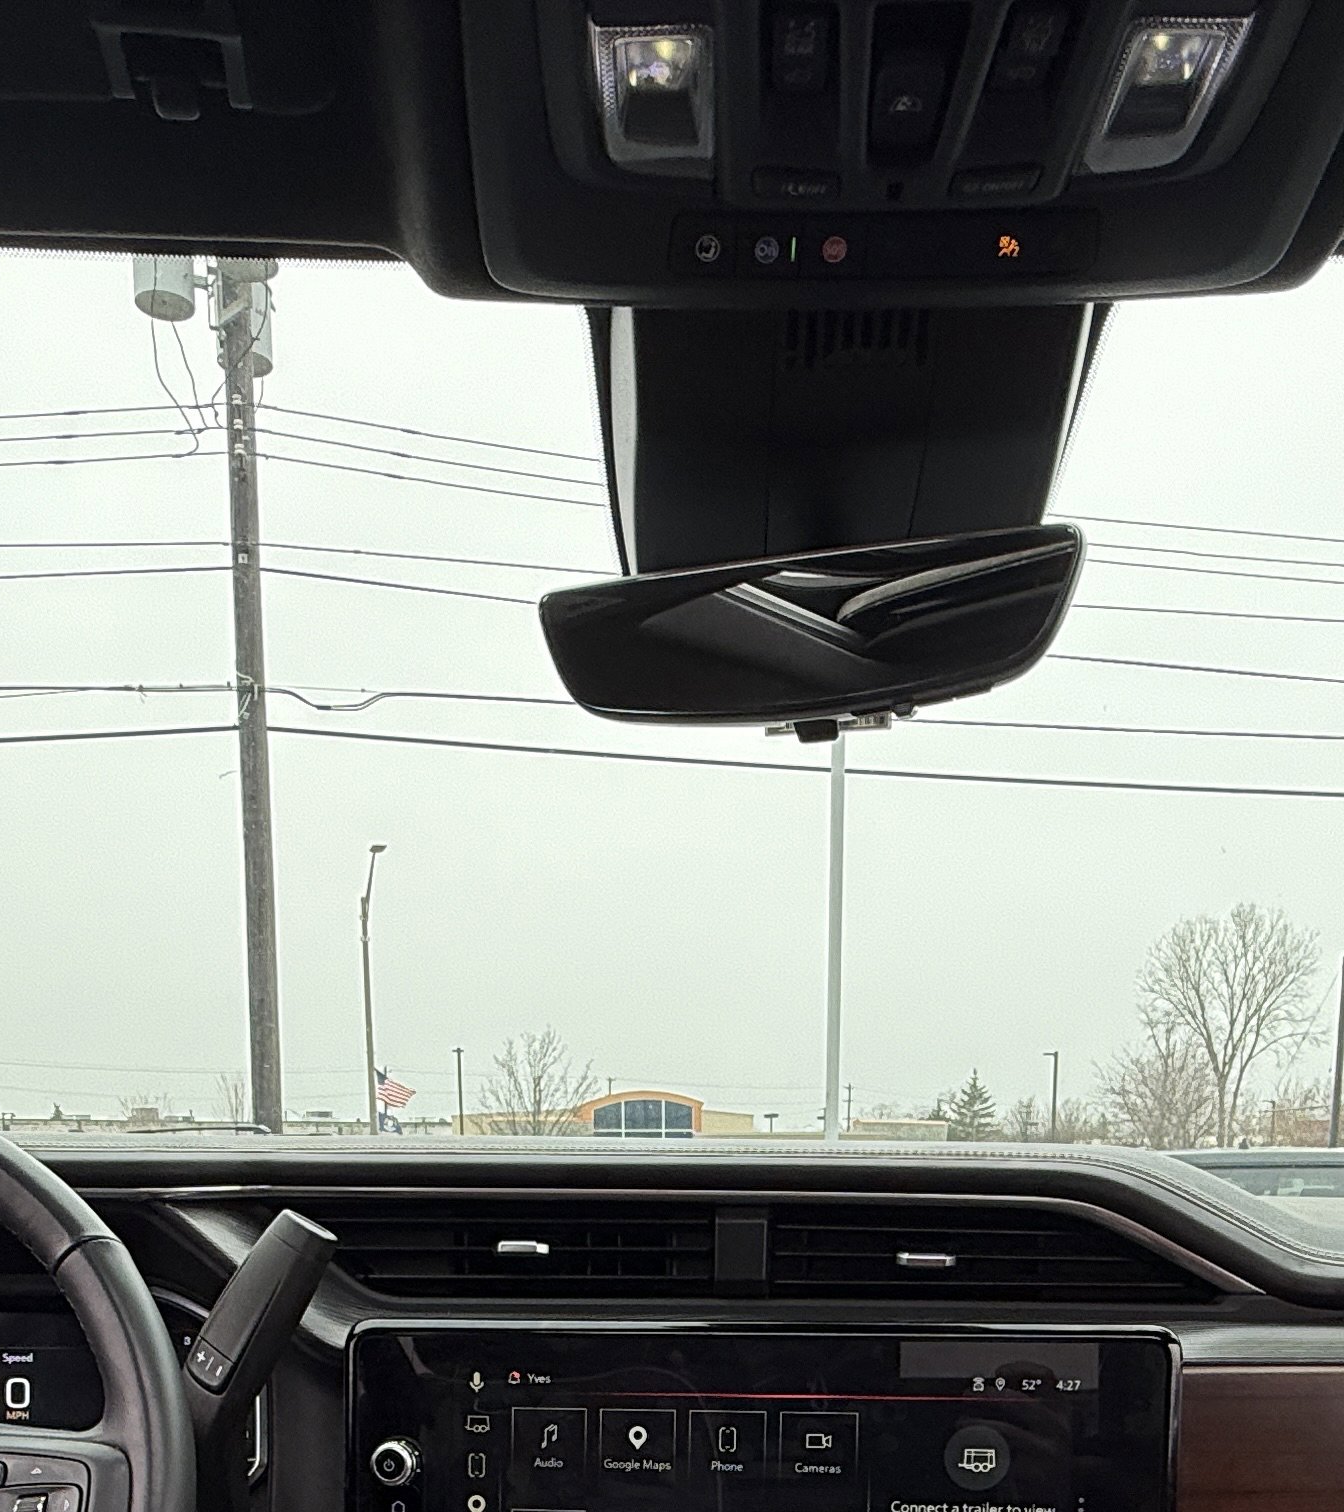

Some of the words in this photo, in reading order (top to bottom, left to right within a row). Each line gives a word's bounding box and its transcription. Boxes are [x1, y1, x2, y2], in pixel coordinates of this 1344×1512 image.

[2, 1352, 34, 1365] Speed
[527, 1373, 552, 1384] Yves
[1056, 1379, 1082, 1391] 4:27
[5, 1377, 31, 1409] 0
[5, 1410, 30, 1420] MPH
[534, 1457, 564, 1468] Audio
[604, 1459, 641, 1472] Google
[643, 1460, 672, 1472] Maps
[711, 1460, 744, 1472] Phone
[794, 1462, 842, 1474] Cameras
